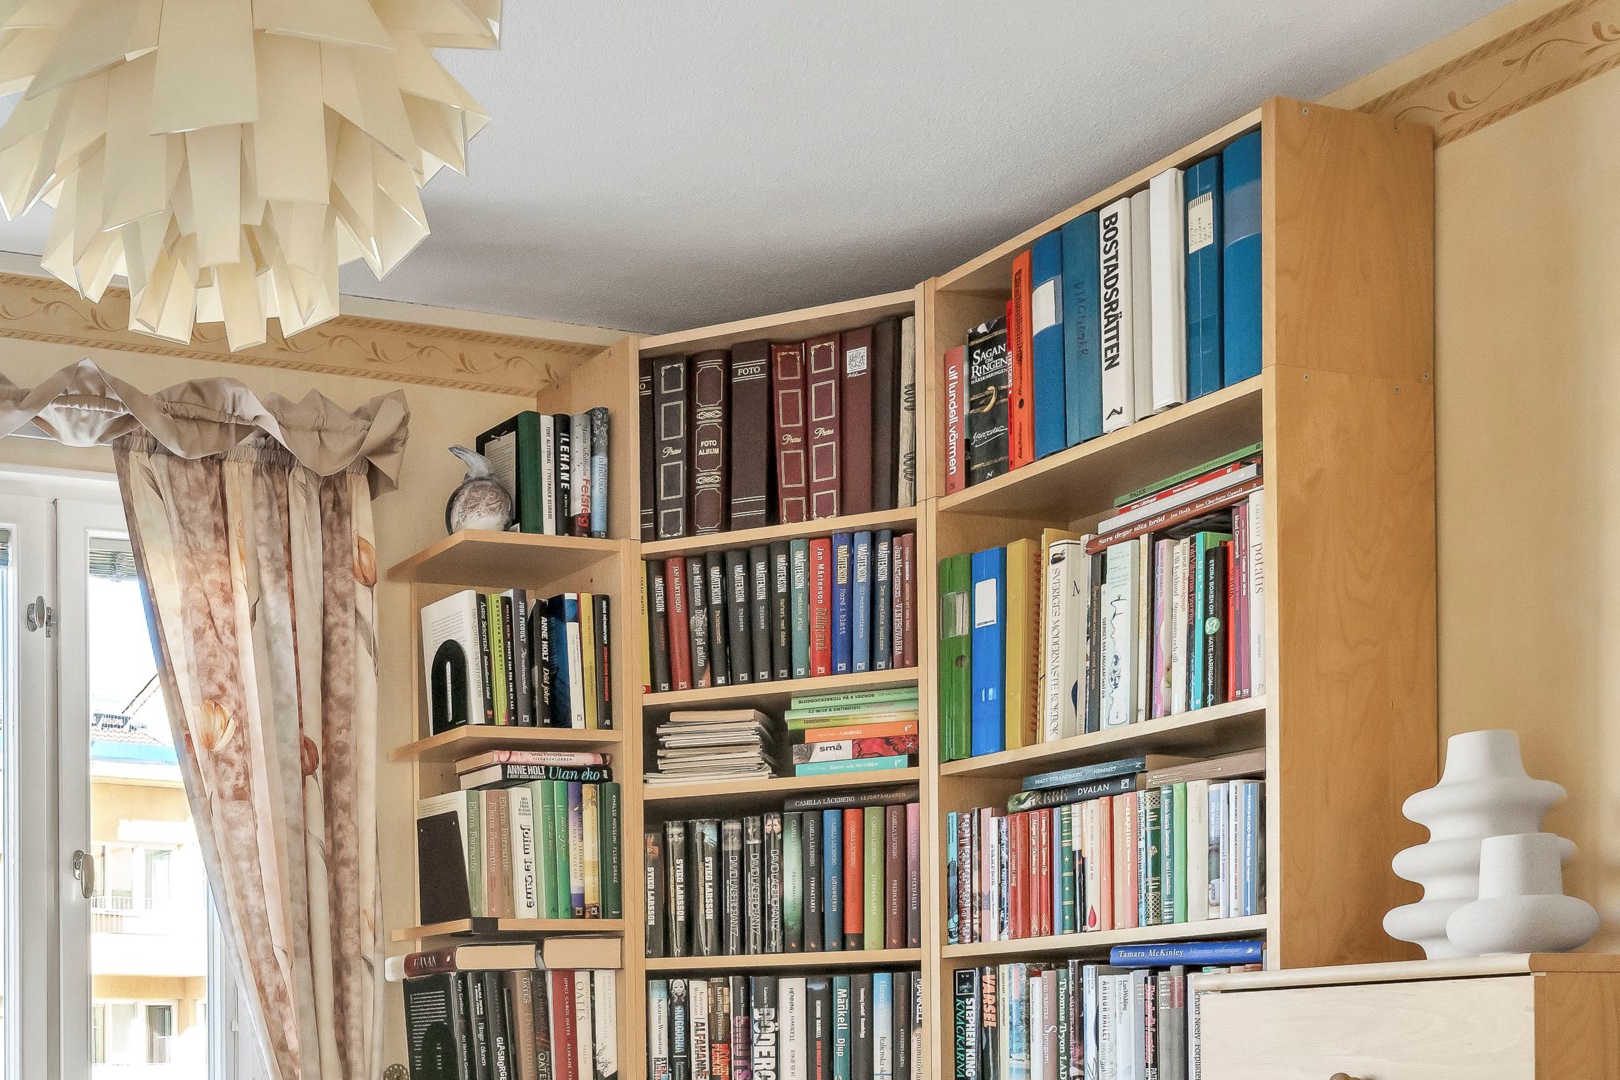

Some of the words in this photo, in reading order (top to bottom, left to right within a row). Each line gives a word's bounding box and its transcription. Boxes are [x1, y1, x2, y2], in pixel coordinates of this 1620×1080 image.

[1103, 212, 1120, 372] BOSTADSRÄTTEN
[973, 344, 1006, 366] SAGAN
[737, 366, 761, 376] FOTO
[971, 360, 1008, 379] RINGEN
[698, 447, 720, 455] ALBUM
[700, 439, 717, 447] FOTO
[560, 439, 570, 490] LEHANE
[1252, 545, 1263, 593] potatis
[1052, 567, 1061, 618] SVERIGES
[541, 616, 549, 638] ANNE
[541, 641, 549, 661] HOLT
[1051, 621, 1060, 687] MODERNASTE
[1050, 690, 1059, 736] KOKBOK
[819, 743, 842, 752] små
[548, 768, 578, 780] Utan
[582, 769, 600, 781] eko
[823, 796, 855, 805] LÄCKBERG
[1077, 783, 1110, 796] DVALAN
[705, 881, 713, 920] LARSSON
[1119, 950, 1145, 958] Tamara
[1148, 948, 1184, 958] McKinley
[837, 988, 848, 1031] Mankell
[982, 974, 997, 1028] VARSEL
[965, 998, 976, 1047] STEPHEN
[957, 1000, 966, 1078] KNACKARNA
[966, 1050, 975, 1077] KING
